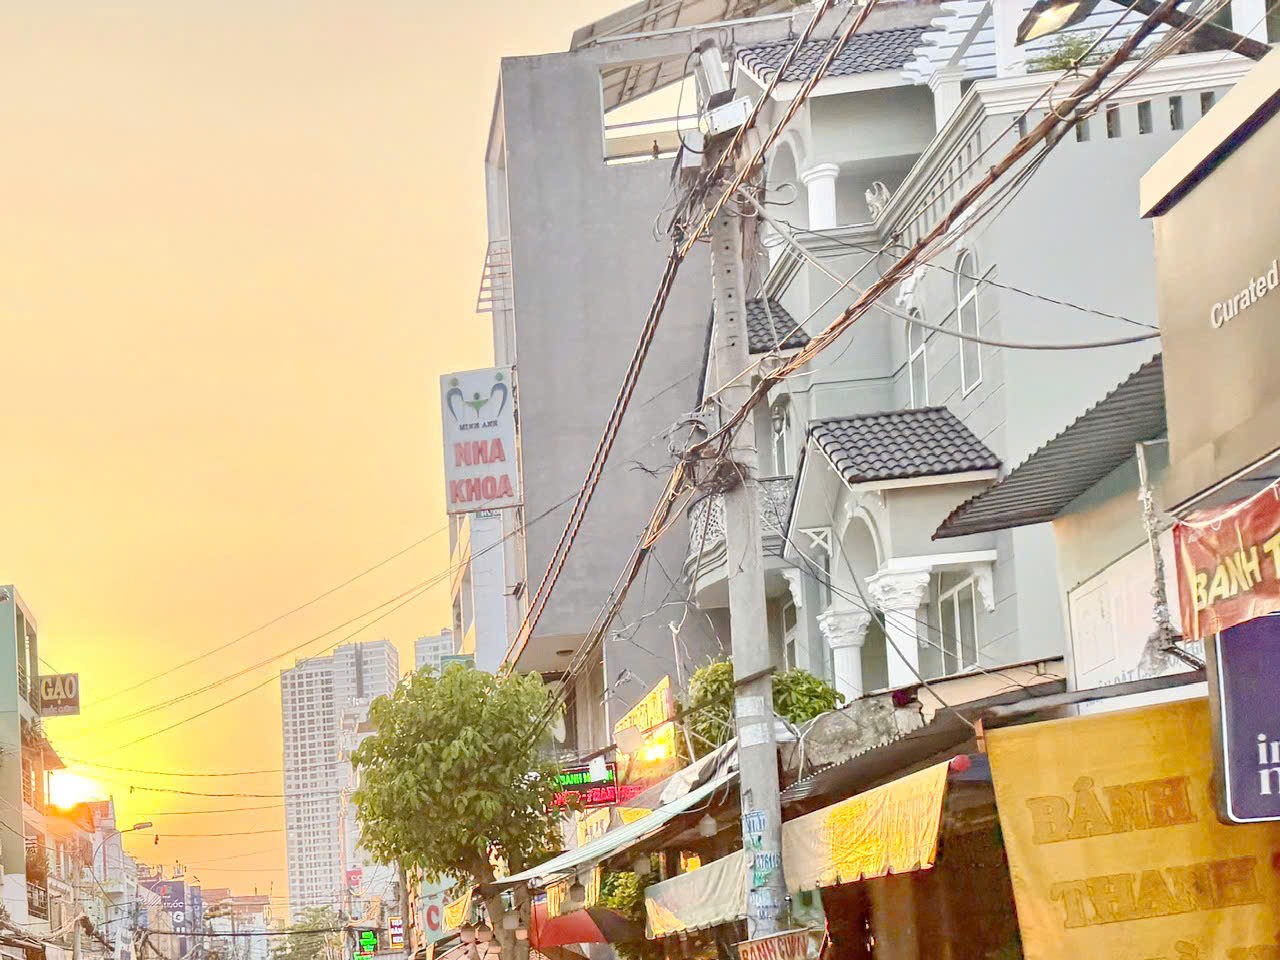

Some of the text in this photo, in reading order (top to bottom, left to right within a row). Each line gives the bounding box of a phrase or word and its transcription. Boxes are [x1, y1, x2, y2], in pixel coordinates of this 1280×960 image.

[1209, 258, 1279, 329] Curated
[459, 421, 480, 431] MINH
[453, 437, 506, 468] NHA
[449, 474, 515, 504] KHOA
[41, 676, 77, 705] GẠO
